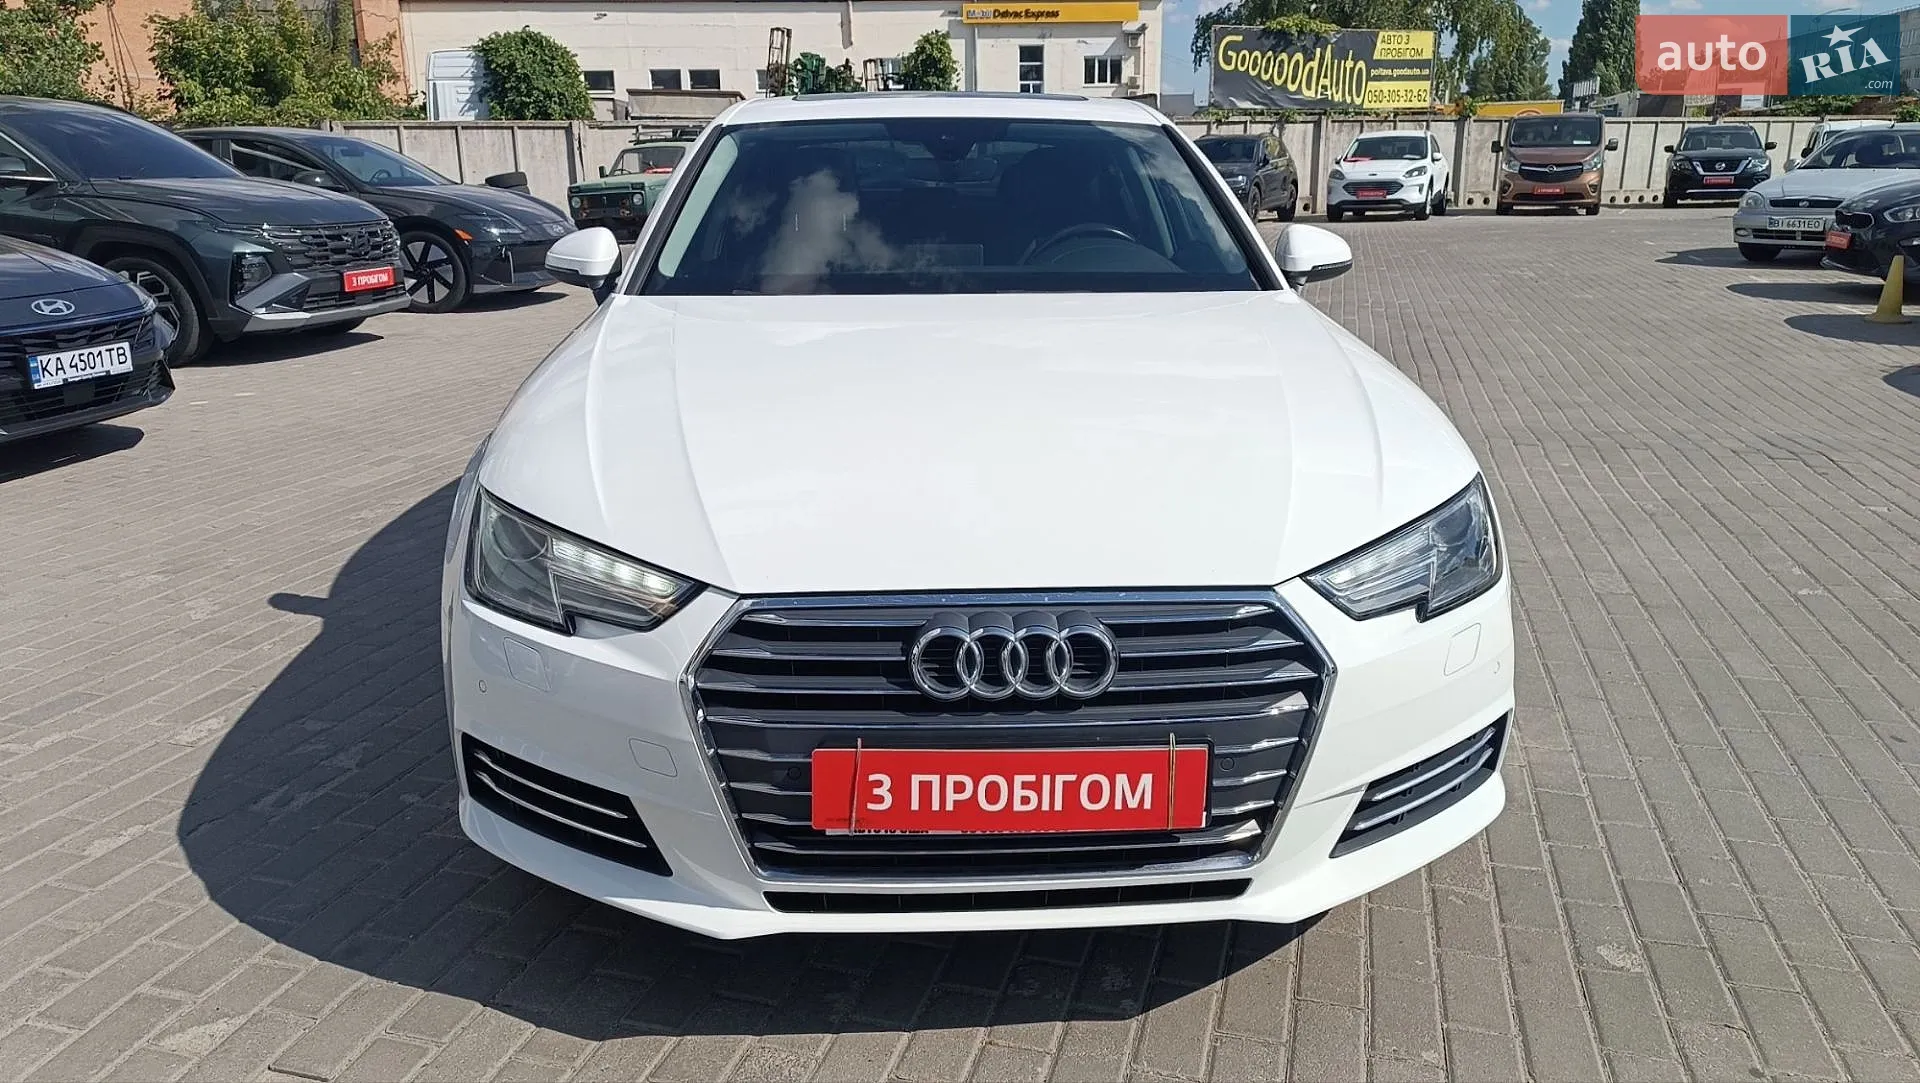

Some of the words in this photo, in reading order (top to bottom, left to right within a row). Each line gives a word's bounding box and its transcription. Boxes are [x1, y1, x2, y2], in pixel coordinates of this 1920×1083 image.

[993, 9, 1023, 18] Delvac
[1024, 9, 1060, 21] Express
[1380, 34, 1403, 45] АВТО
[1380, 47, 1424, 58] ПРОБІГОМ
[1367, 88, 1428, 103] 050-305-32-62
[910, 773, 1153, 812] ПРОБІГОМ
